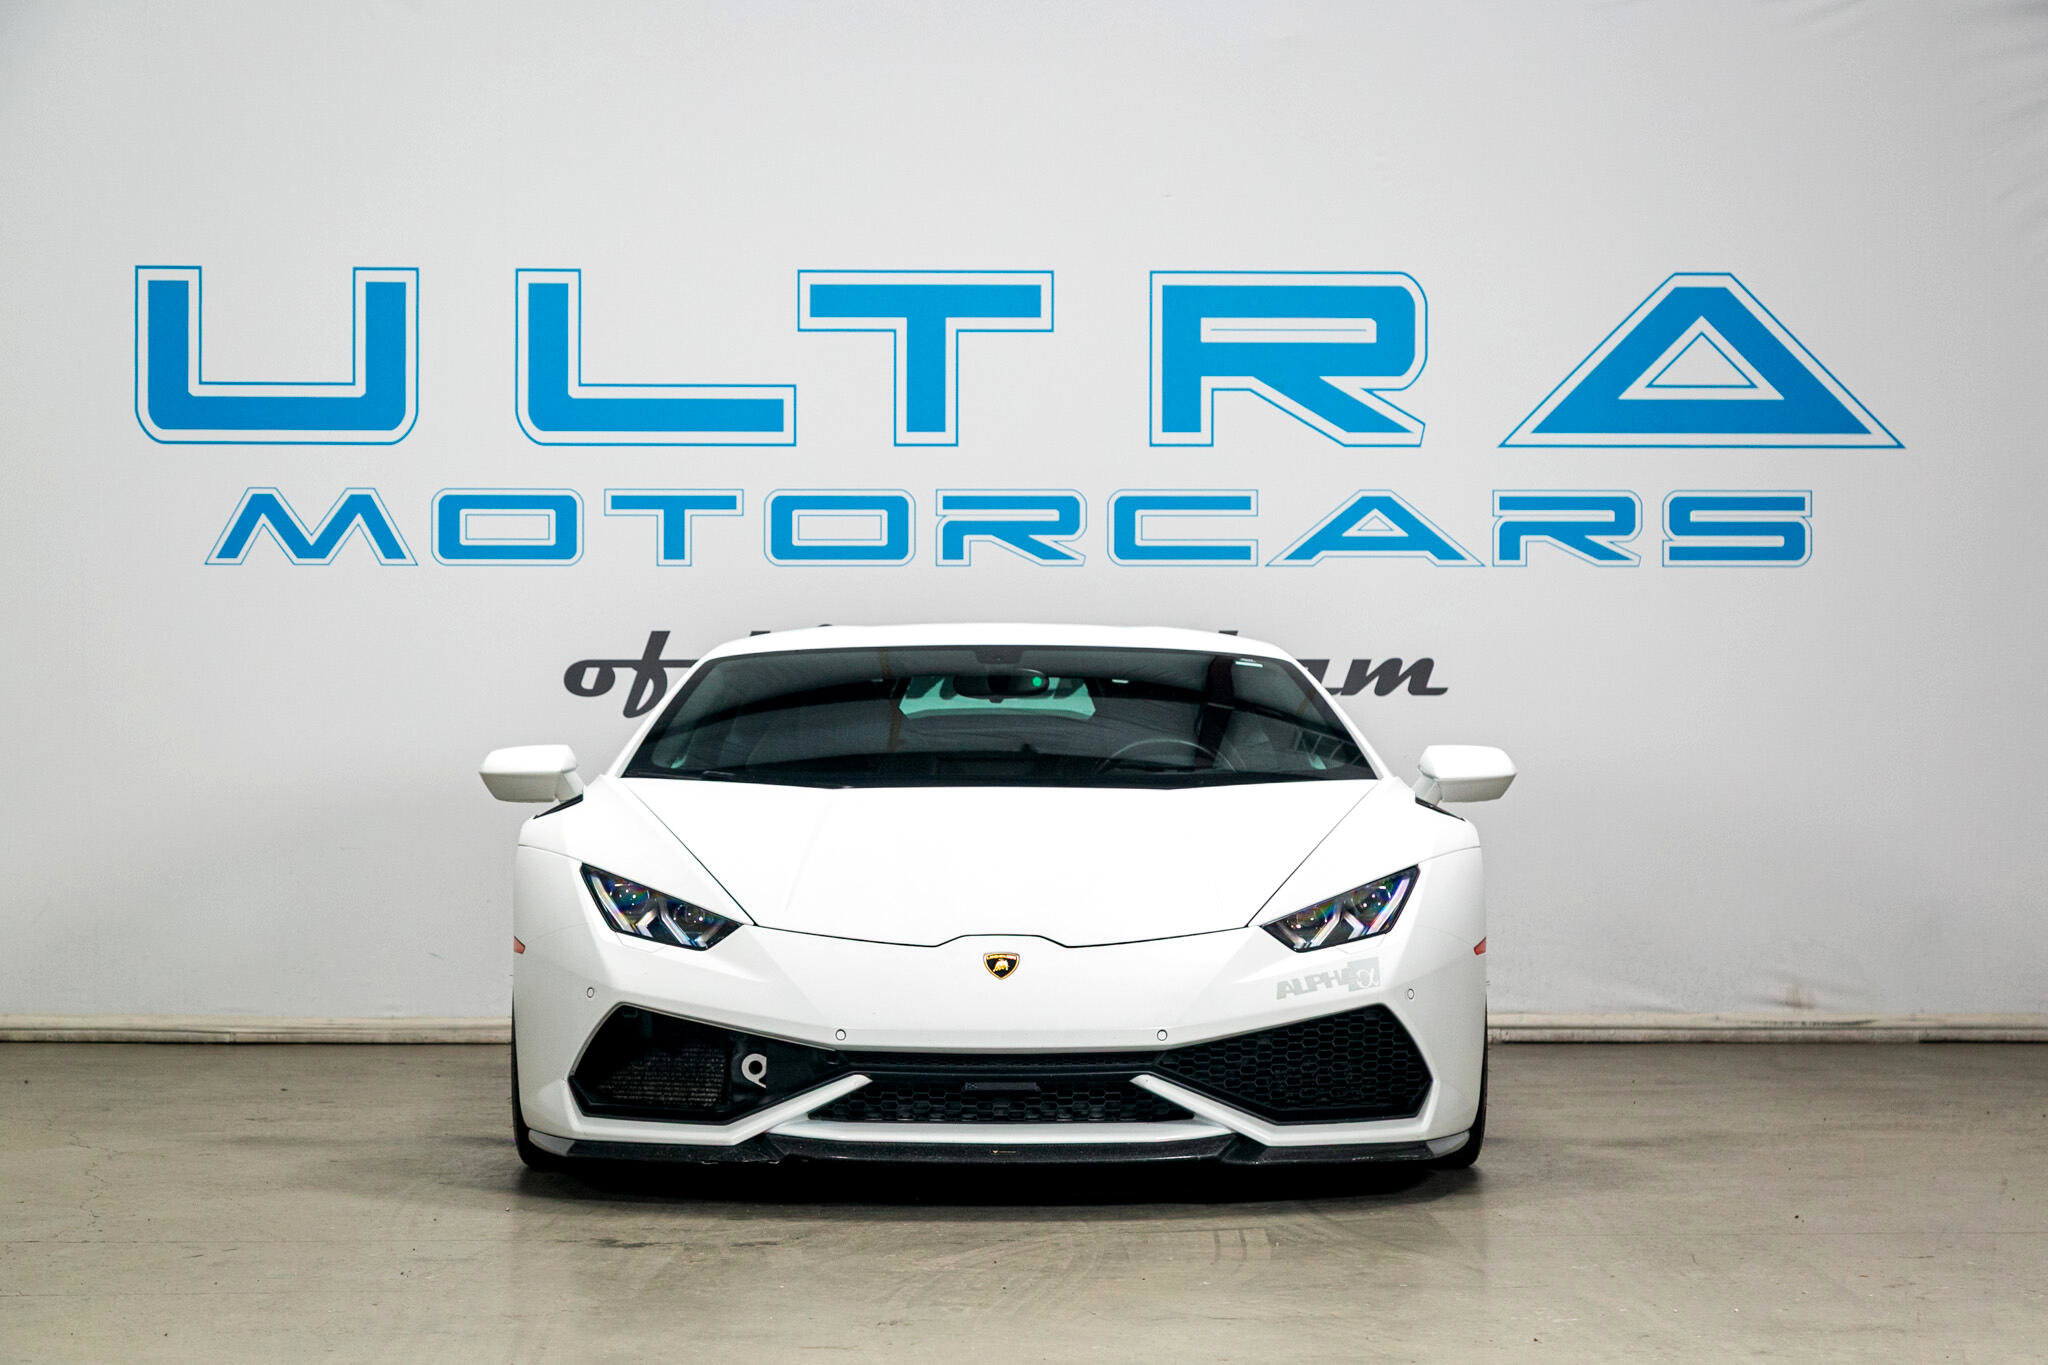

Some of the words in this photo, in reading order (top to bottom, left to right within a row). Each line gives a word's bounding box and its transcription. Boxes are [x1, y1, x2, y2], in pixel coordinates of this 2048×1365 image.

[134, 265, 1906, 449] ULTRA
[204, 487, 1814, 567] MOTORCARS
[563, 630, 699, 718] of
